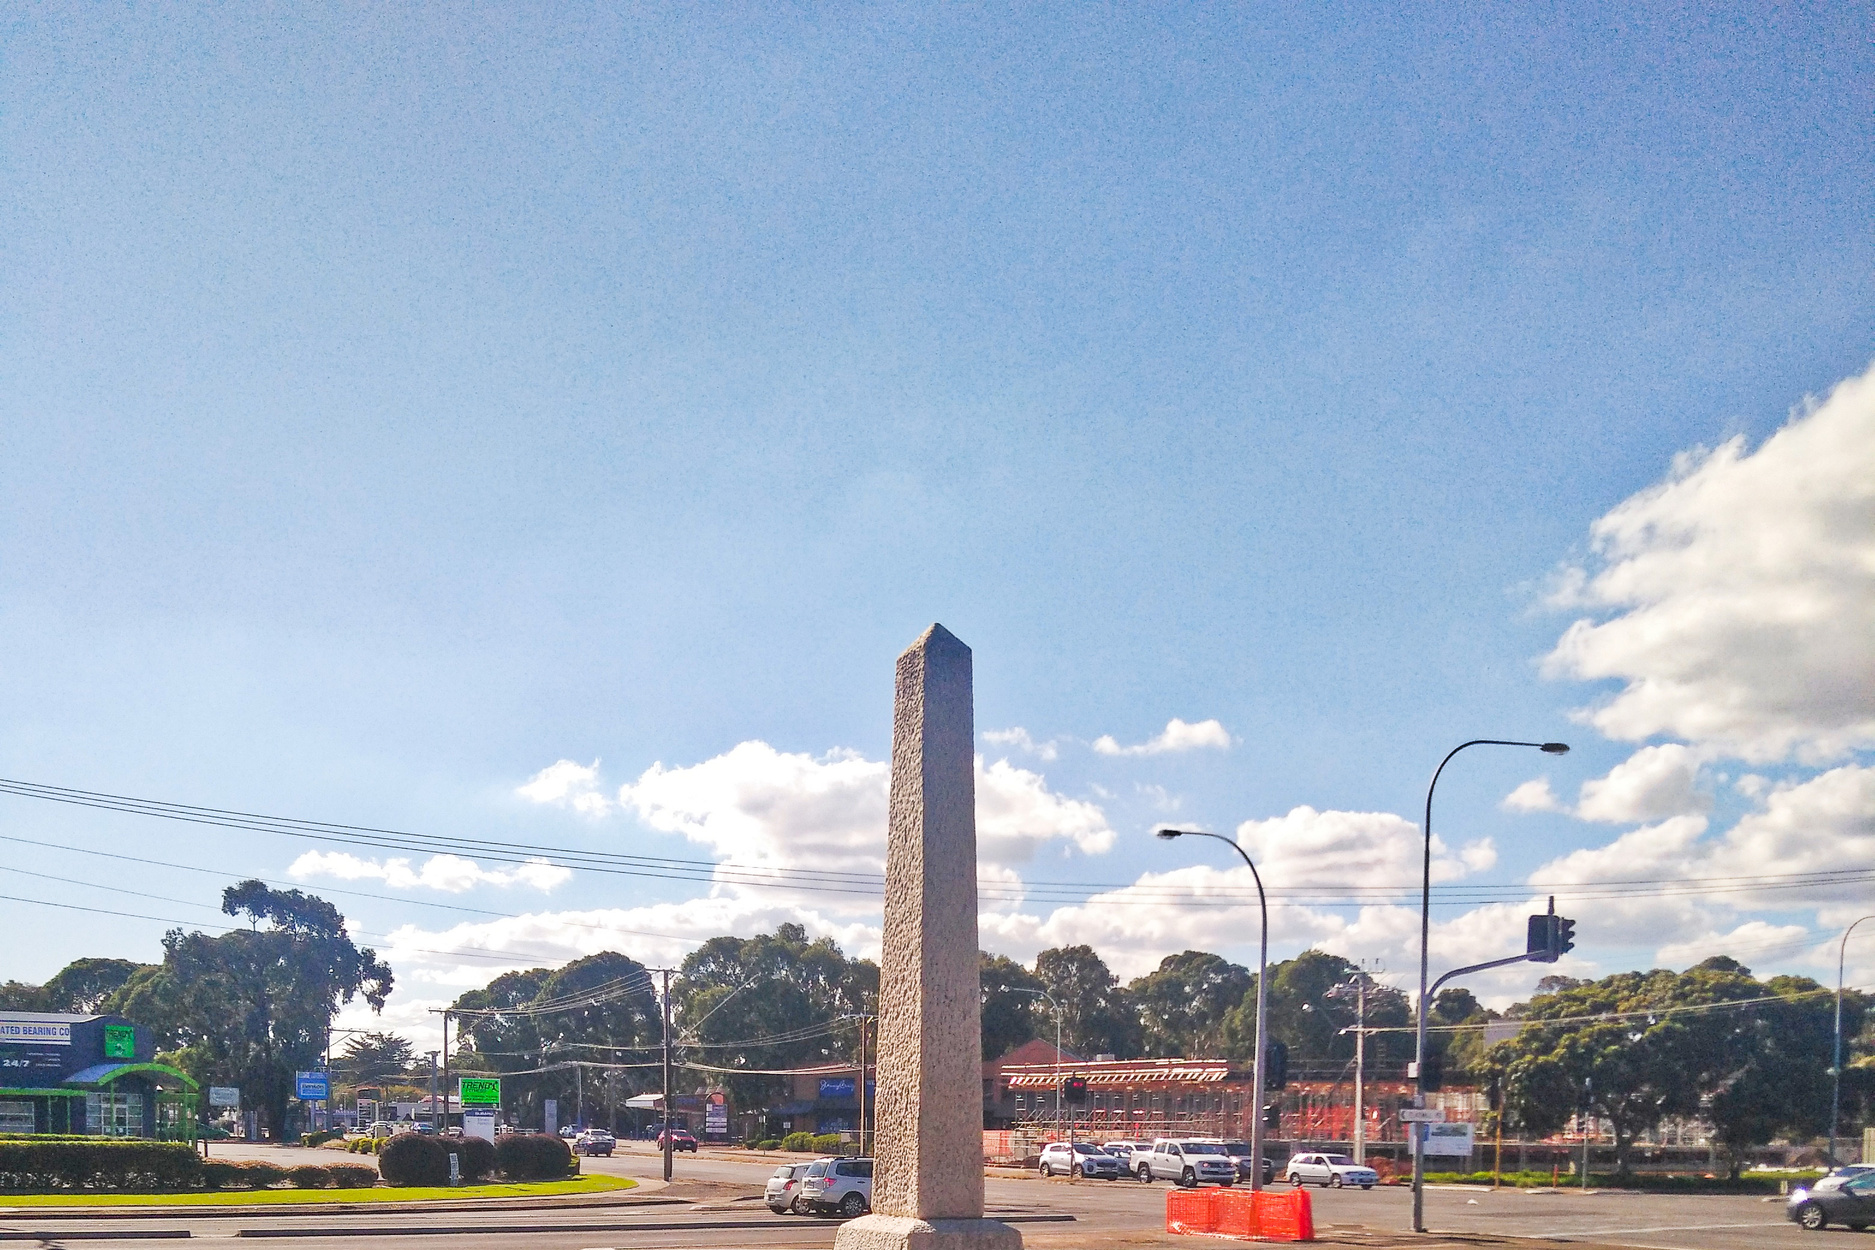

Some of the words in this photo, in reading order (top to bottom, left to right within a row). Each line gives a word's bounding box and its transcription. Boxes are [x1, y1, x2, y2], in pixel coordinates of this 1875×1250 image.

[22, 1026, 57, 1036] BEARING
[59, 1027, 70, 1036] CO
[2, 1059, 30, 1067] 24/7
